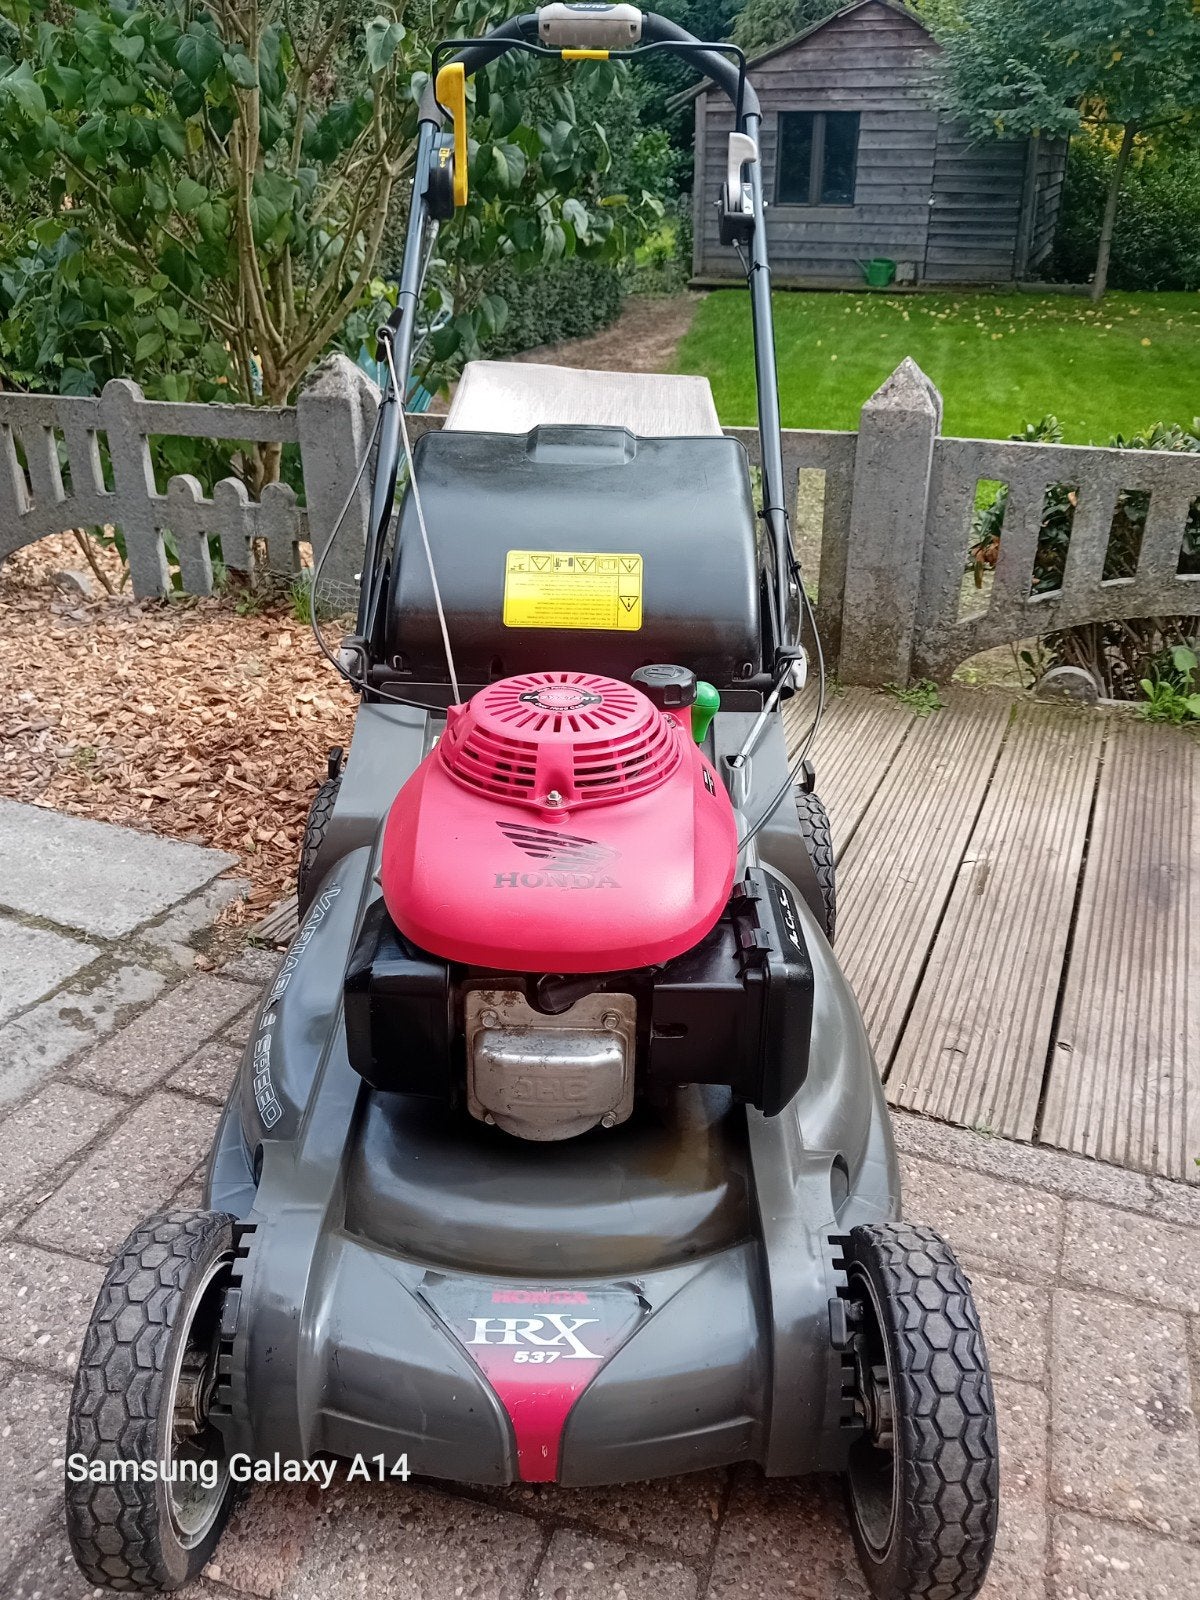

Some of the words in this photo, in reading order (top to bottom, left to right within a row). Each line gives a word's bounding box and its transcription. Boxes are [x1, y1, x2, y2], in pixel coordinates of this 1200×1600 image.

[493, 871, 622, 889] HONDA
[253, 1034, 283, 1129] SPEED
[491, 1289, 590, 1305] HONDA
[465, 1313, 605, 1359] HRX
[513, 1351, 560, 1364] 537
